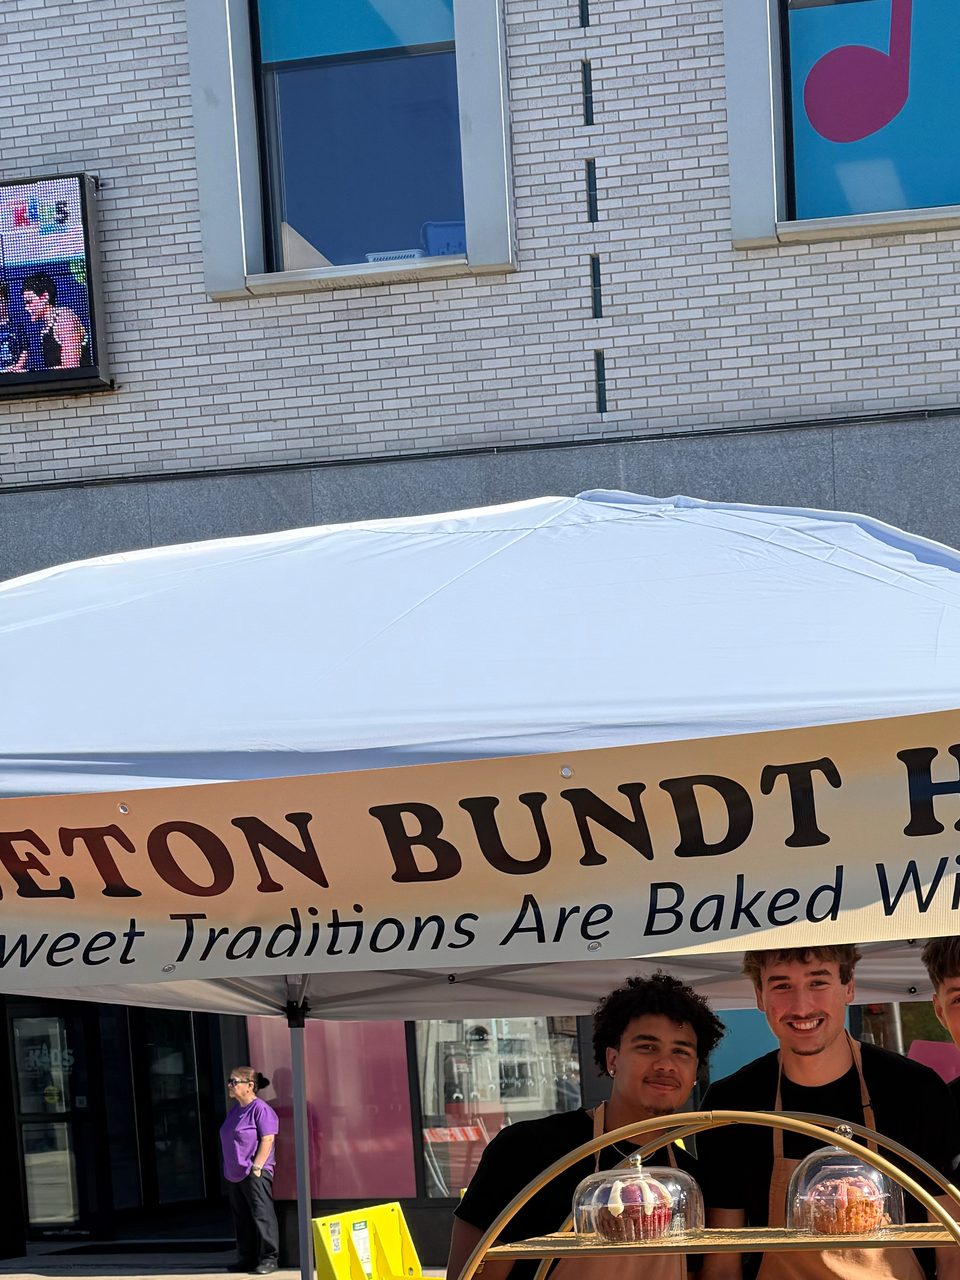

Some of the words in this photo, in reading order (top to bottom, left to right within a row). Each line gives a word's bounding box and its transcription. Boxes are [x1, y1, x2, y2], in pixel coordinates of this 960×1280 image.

[0, 811, 329, 900] ETON
[369, 757, 843, 883] BUNDT
[0, 917, 146, 969] weet
[168, 903, 480, 964] Traditions
[501, 894, 613, 945] Are
[643, 865, 845, 936] Baked
